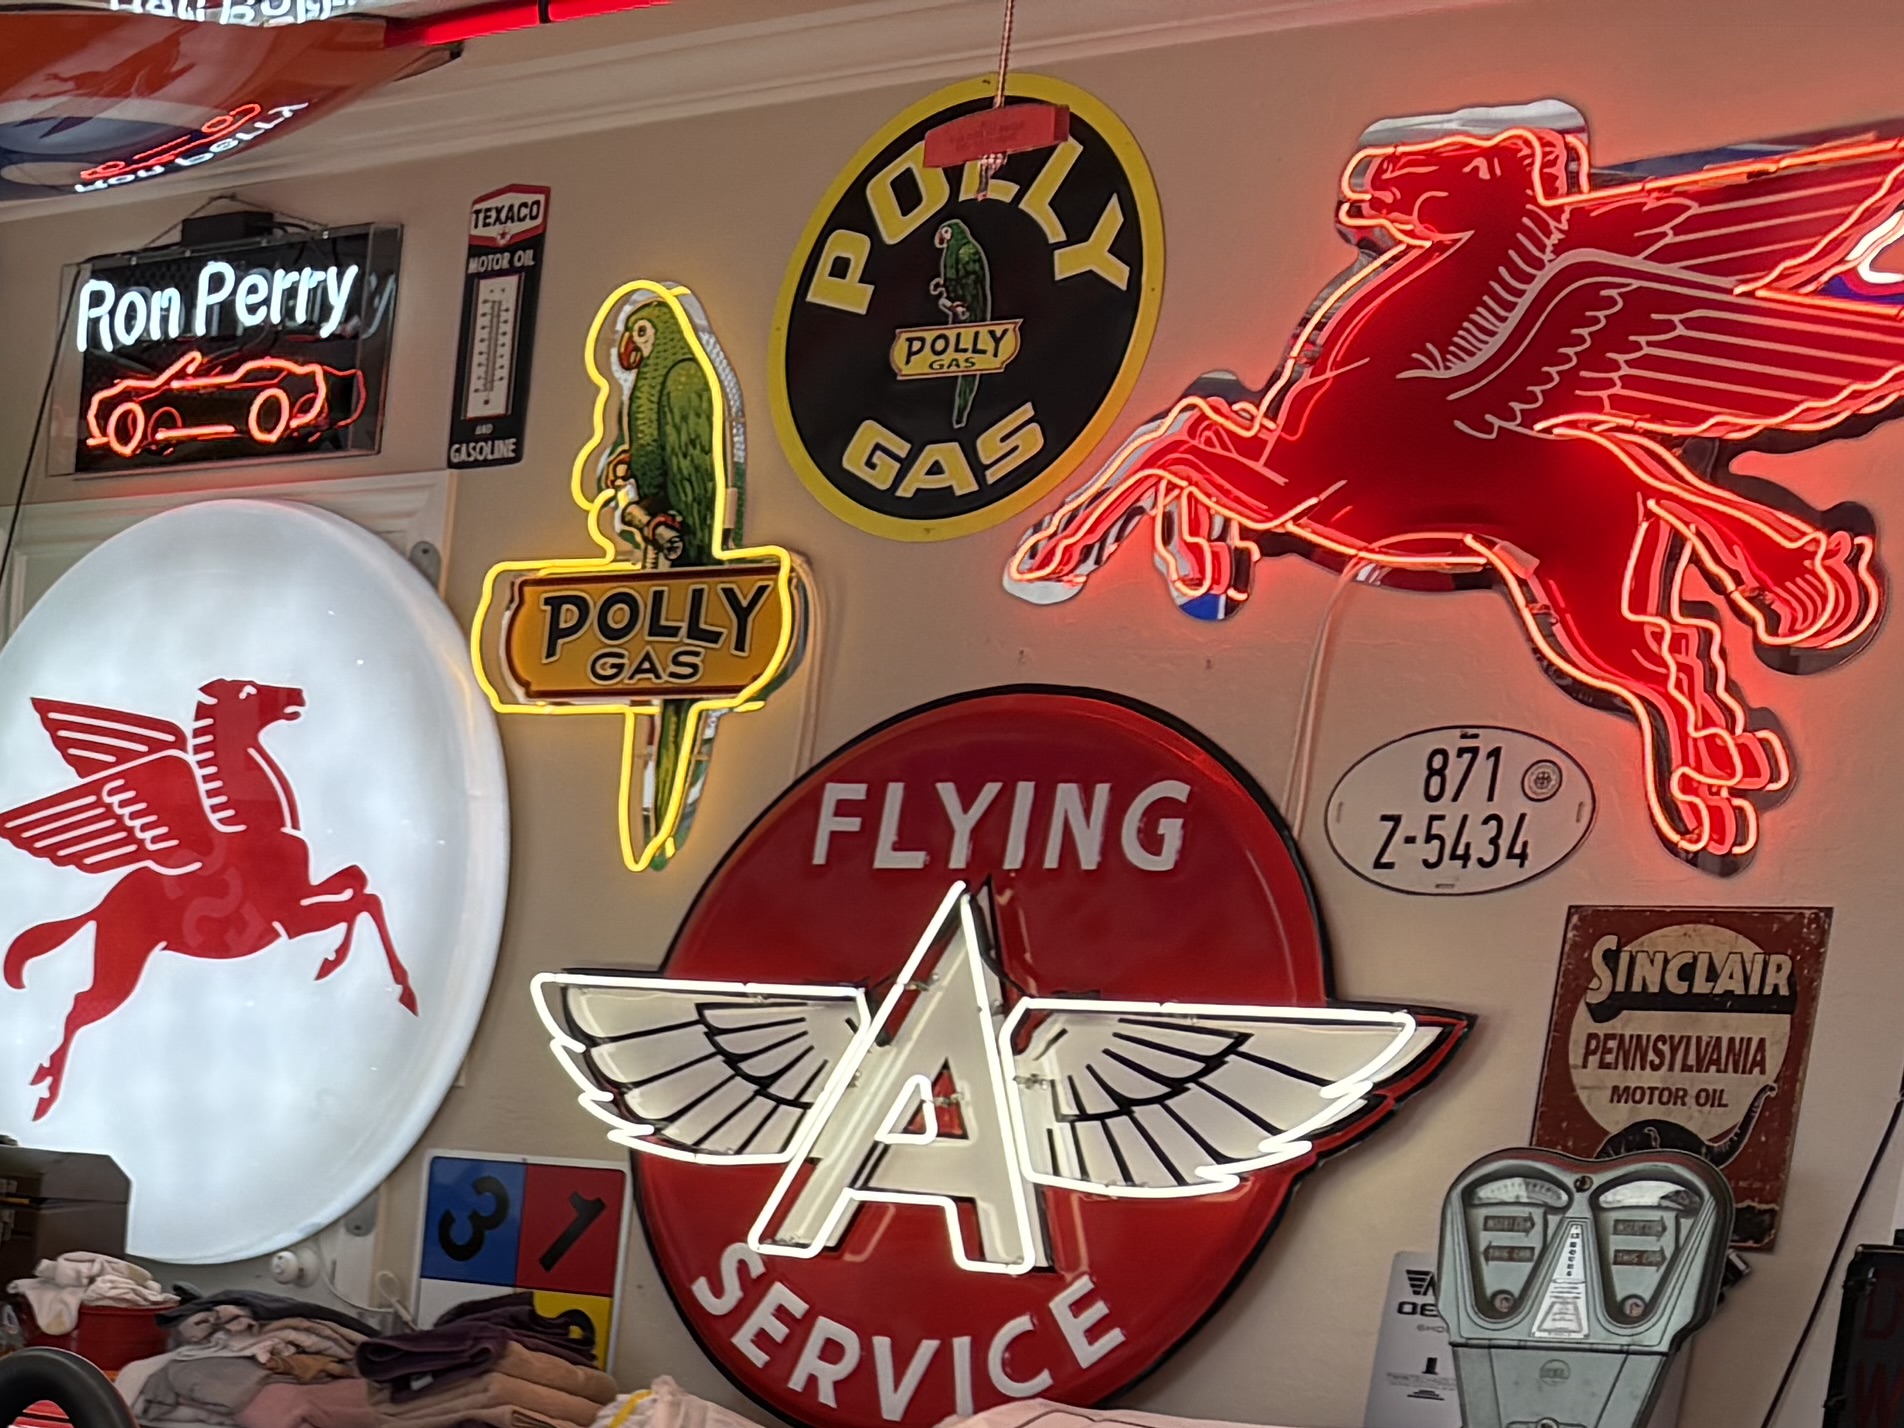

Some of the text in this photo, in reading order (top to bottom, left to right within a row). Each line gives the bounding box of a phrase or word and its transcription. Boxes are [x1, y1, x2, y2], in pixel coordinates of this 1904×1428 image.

[472, 199, 541, 229] TEXACO
[469, 248, 535, 274] MOTOR OIL
[76, 261, 359, 353] Ron Perry
[903, 327, 1012, 368] POLLY
[928, 353, 976, 372] GAS
[450, 437, 516, 463] GASOLINE
[475, 424, 494, 436] AND
[842, 402, 1045, 498] GAS
[540, 580, 774, 661] POLLY
[589, 646, 706, 685] GAS
[1422, 746, 1504, 803] 871
[812, 779, 1191, 873] FLYING
[1373, 812, 1530, 870] Z-5434
[1586, 934, 1793, 1004] SINCLAIR
[1582, 1031, 1768, 1077] PENNSYLVANIA
[1609, 1085, 1729, 1109] MOTOR OIL
[439, 1175, 510, 1262] 3
[691, 1242, 1129, 1423] SERVICE
